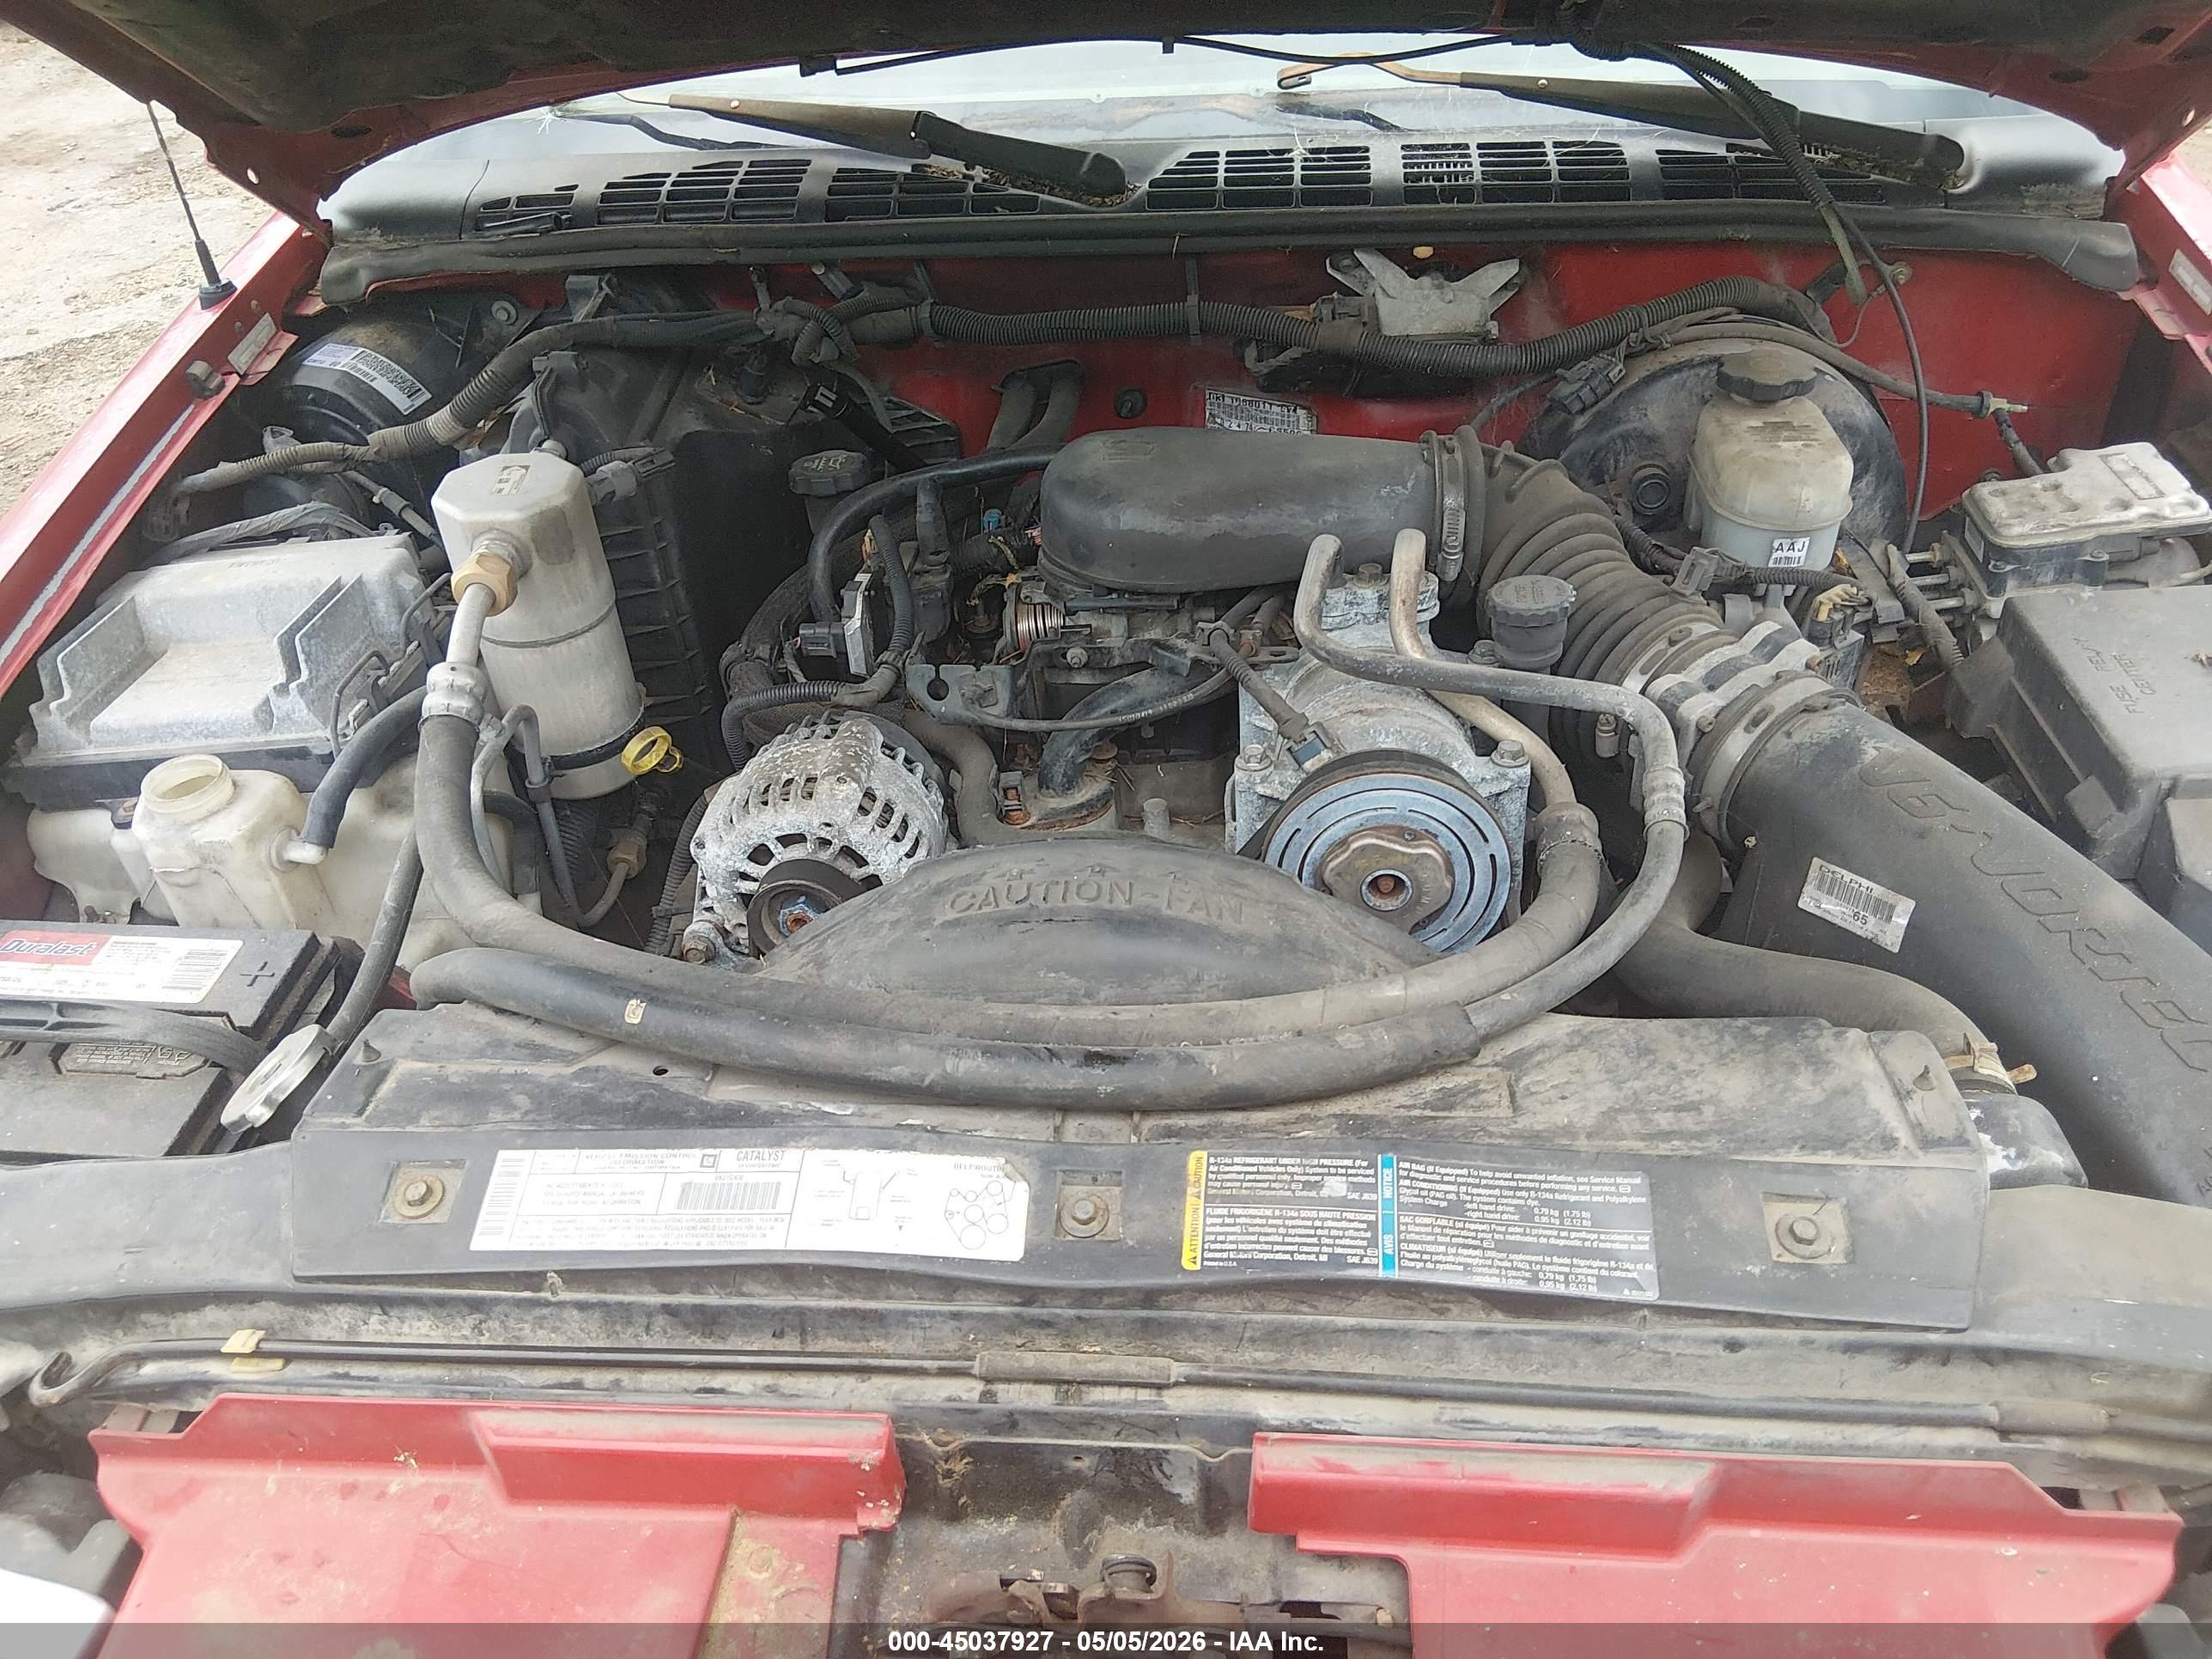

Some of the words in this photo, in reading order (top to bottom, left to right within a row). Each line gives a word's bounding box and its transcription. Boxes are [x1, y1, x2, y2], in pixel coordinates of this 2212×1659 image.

[1775, 542, 1805, 553] AAJ
[1818, 864, 1875, 894] DELPHI
[1852, 911, 1869, 926] 65
[1, 939, 96, 957] Duralast
[736, 1150, 786, 1162] CATALYST
[1193, 1156, 1202, 1188] CAUTION
[1589, 1176, 1615, 1184] Service
[1382, 1168, 1393, 1199] NOTICE
[1399, 1178, 1411, 1187] AIR
[1518, 1179, 1540, 1188] before
[1540, 1182, 1577, 1192] performing
[1188, 1207, 1200, 1254] ATTENTION
[1382, 1234, 1394, 1255] AVIS
